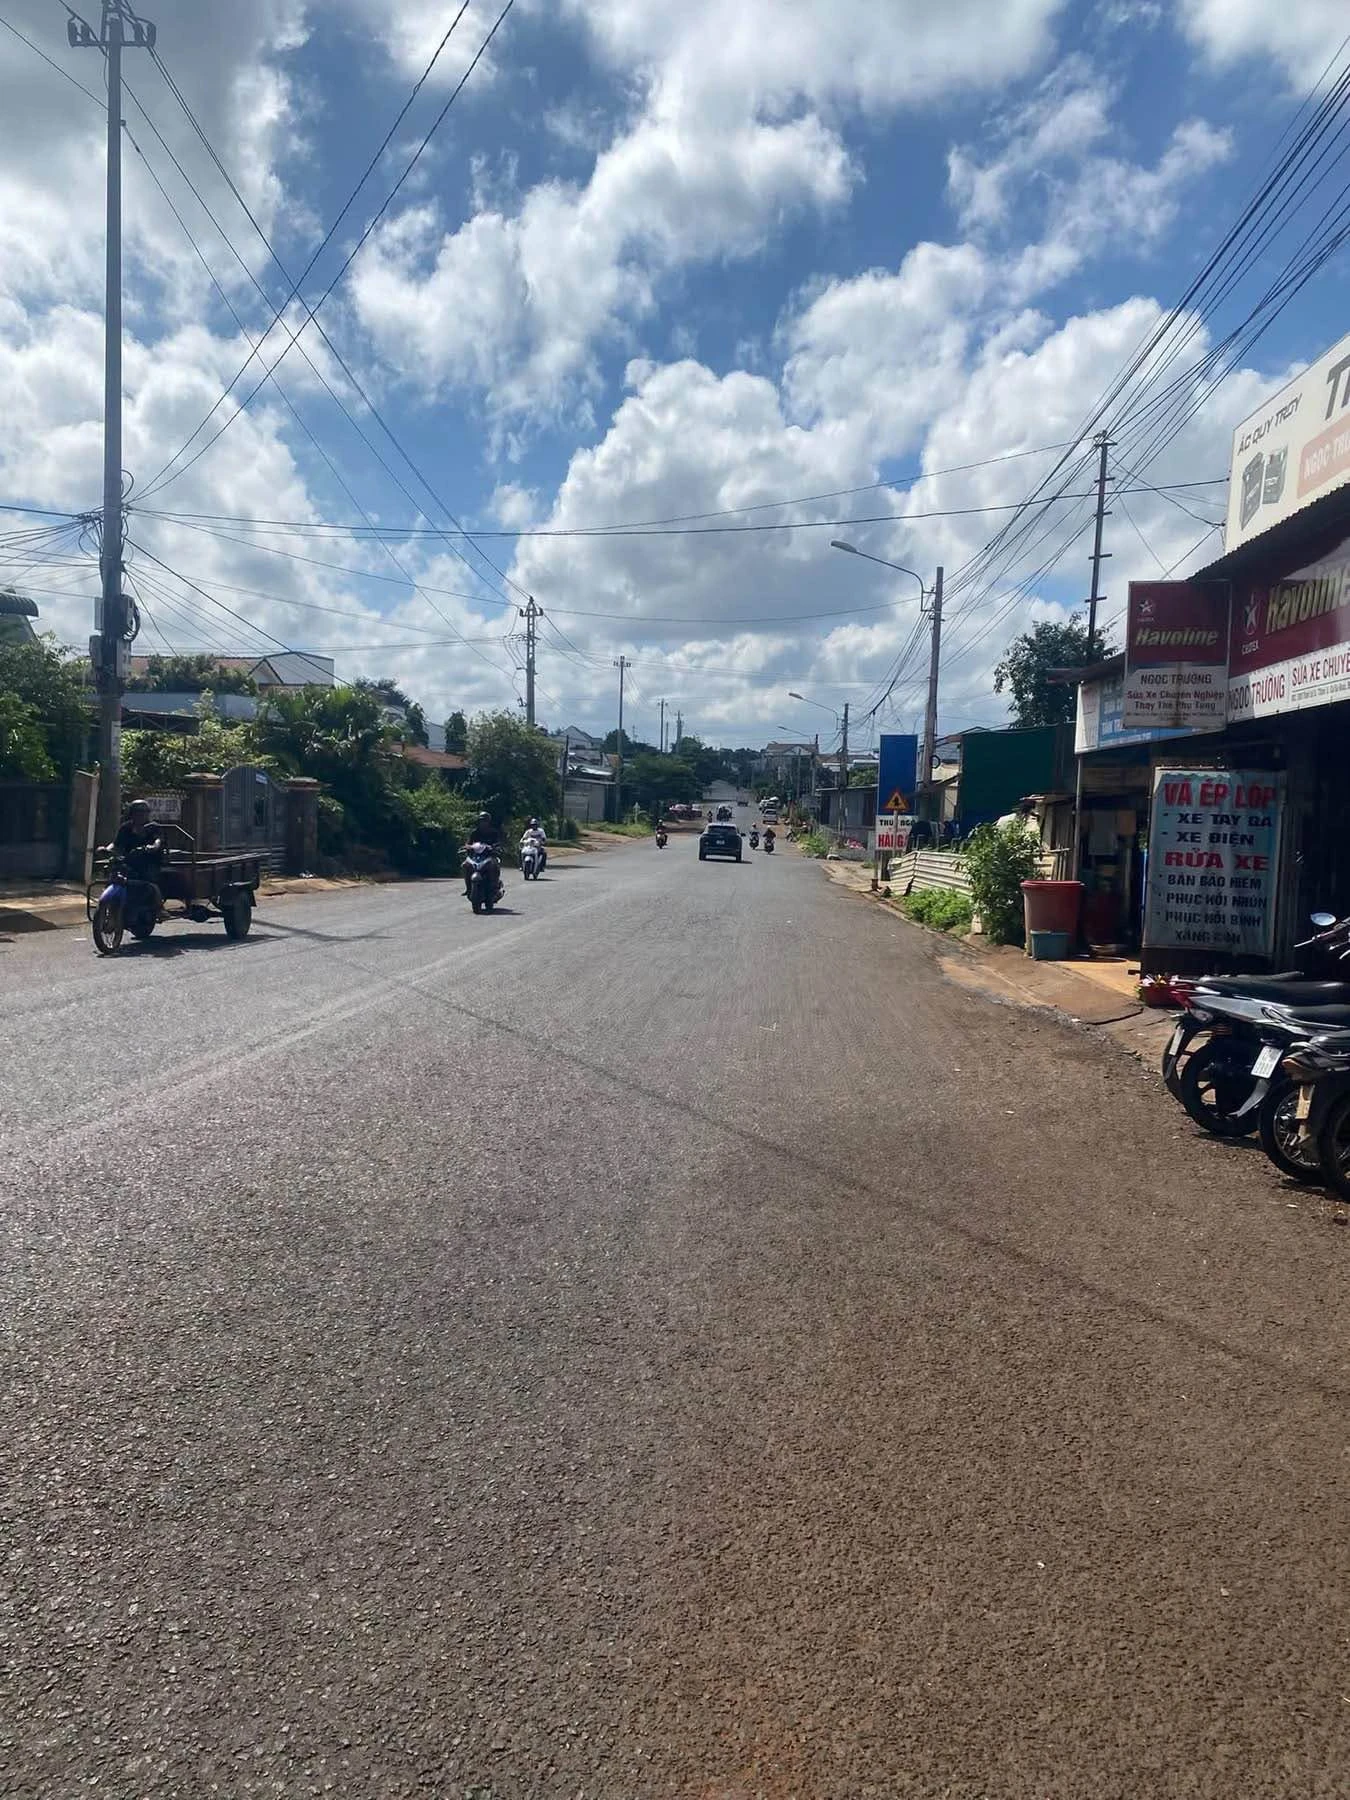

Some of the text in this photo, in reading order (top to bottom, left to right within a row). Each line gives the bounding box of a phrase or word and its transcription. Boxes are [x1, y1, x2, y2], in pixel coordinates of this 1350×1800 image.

[1265, 565, 1350, 635] Havoline
[1136, 627, 1218, 646] Havoline
[1309, 660, 1320, 681] XE
[1199, 779, 1228, 806] ÉP
[1178, 813, 1272, 827] XE TAY GA
[1177, 832, 1202, 842] XE
[1165, 848, 1270, 870] RỬA XE
